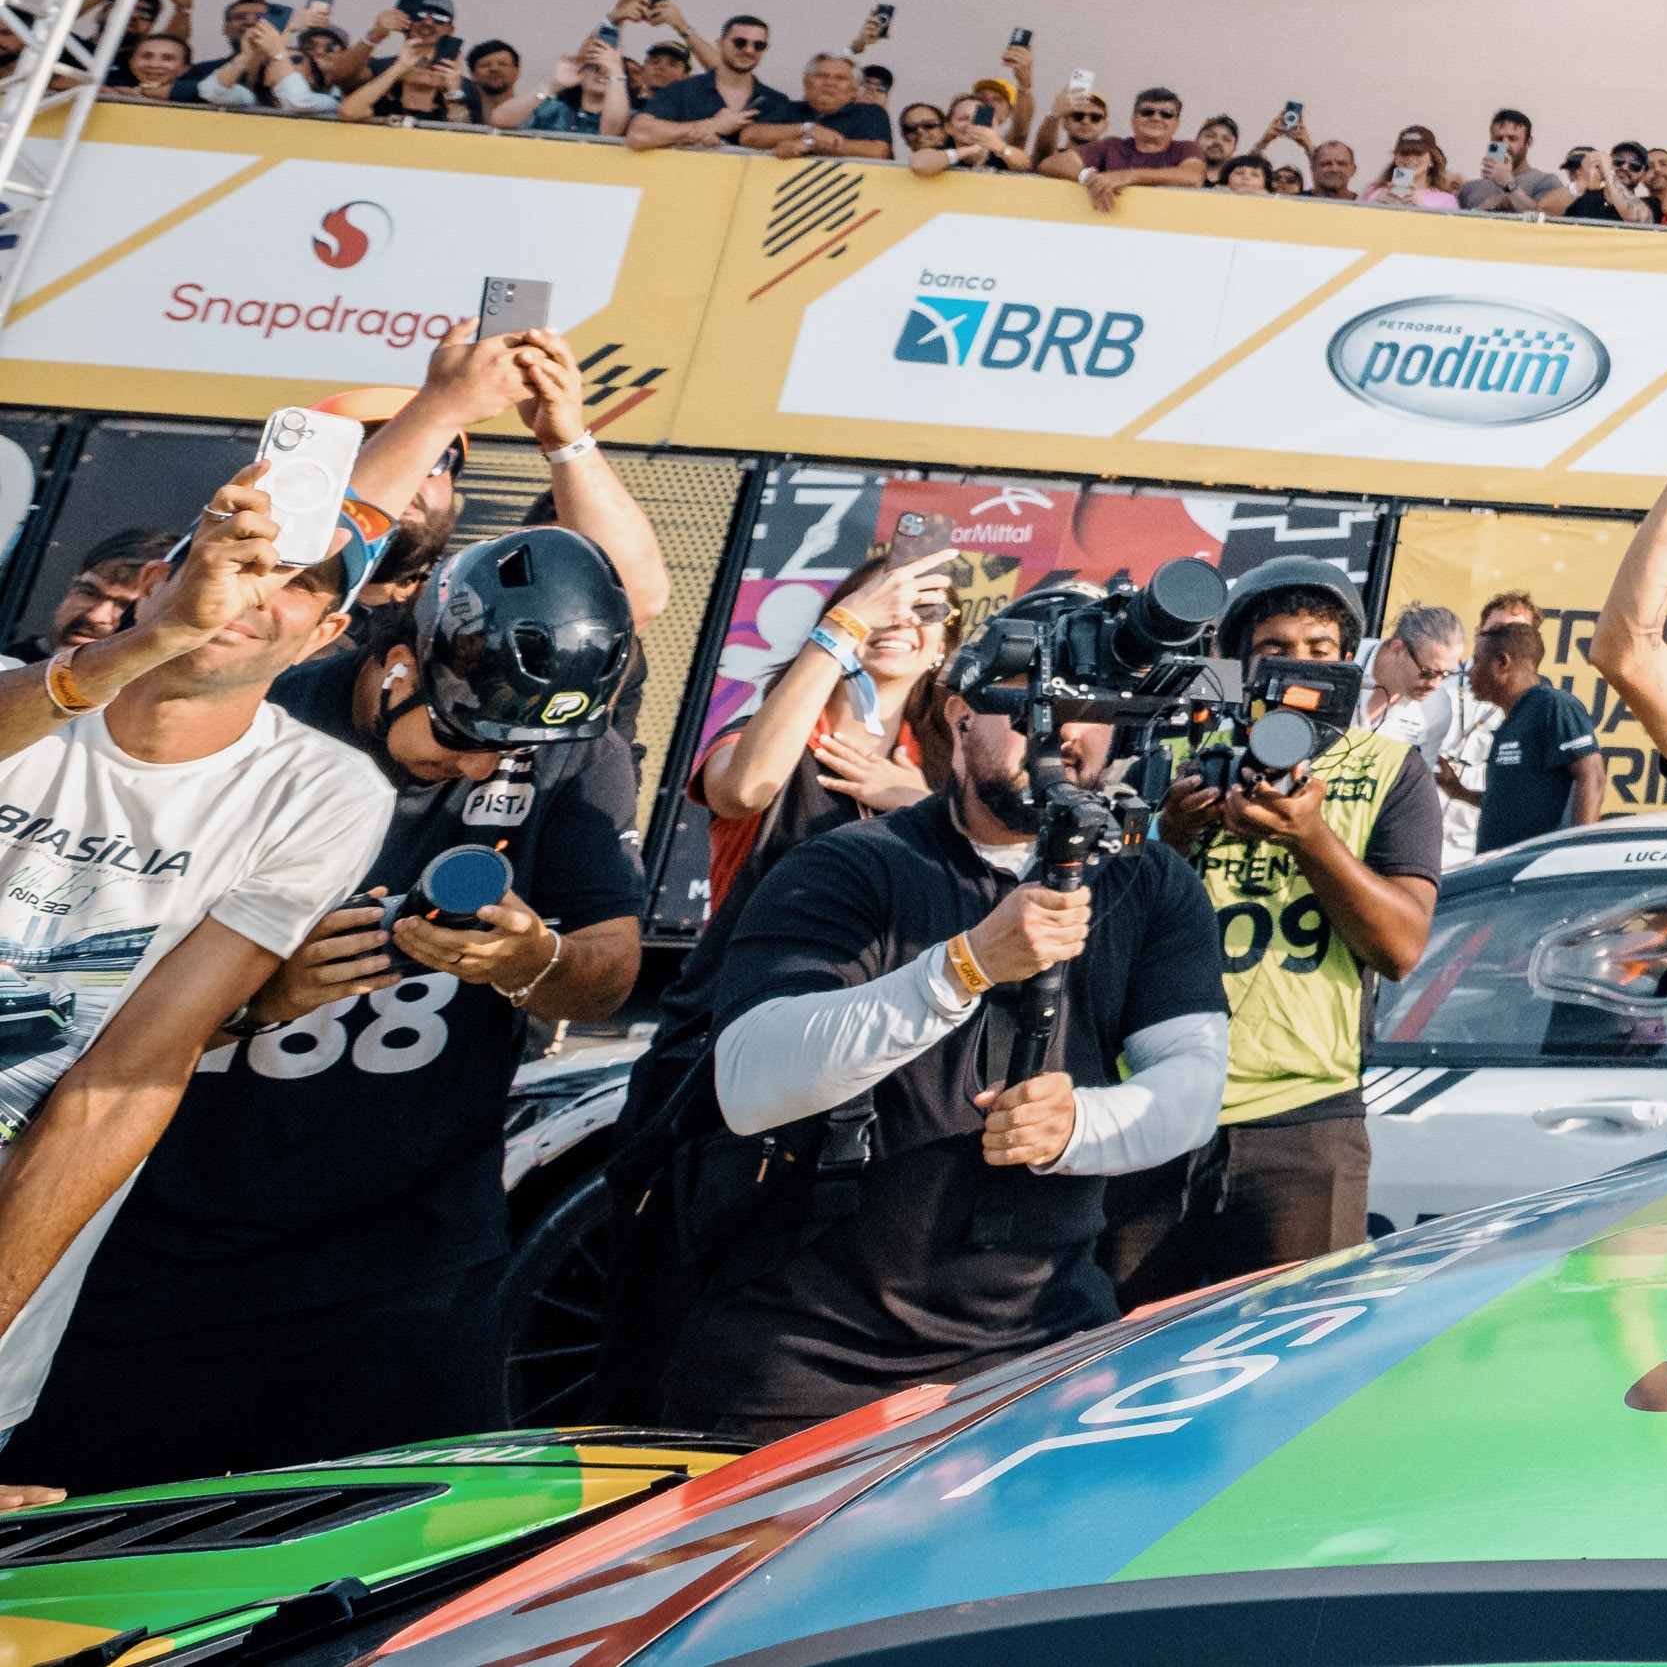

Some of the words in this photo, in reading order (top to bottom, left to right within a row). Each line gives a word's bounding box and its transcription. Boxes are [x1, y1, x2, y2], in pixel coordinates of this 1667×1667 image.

[918, 268, 996, 293] banco
[164, 283, 474, 348] Snapdrago
[1378, 318, 1463, 336] PETROBRAS
[981, 302, 1146, 379] BRB
[1361, 332, 1577, 397] podium
[951, 523, 1034, 544] orMittal
